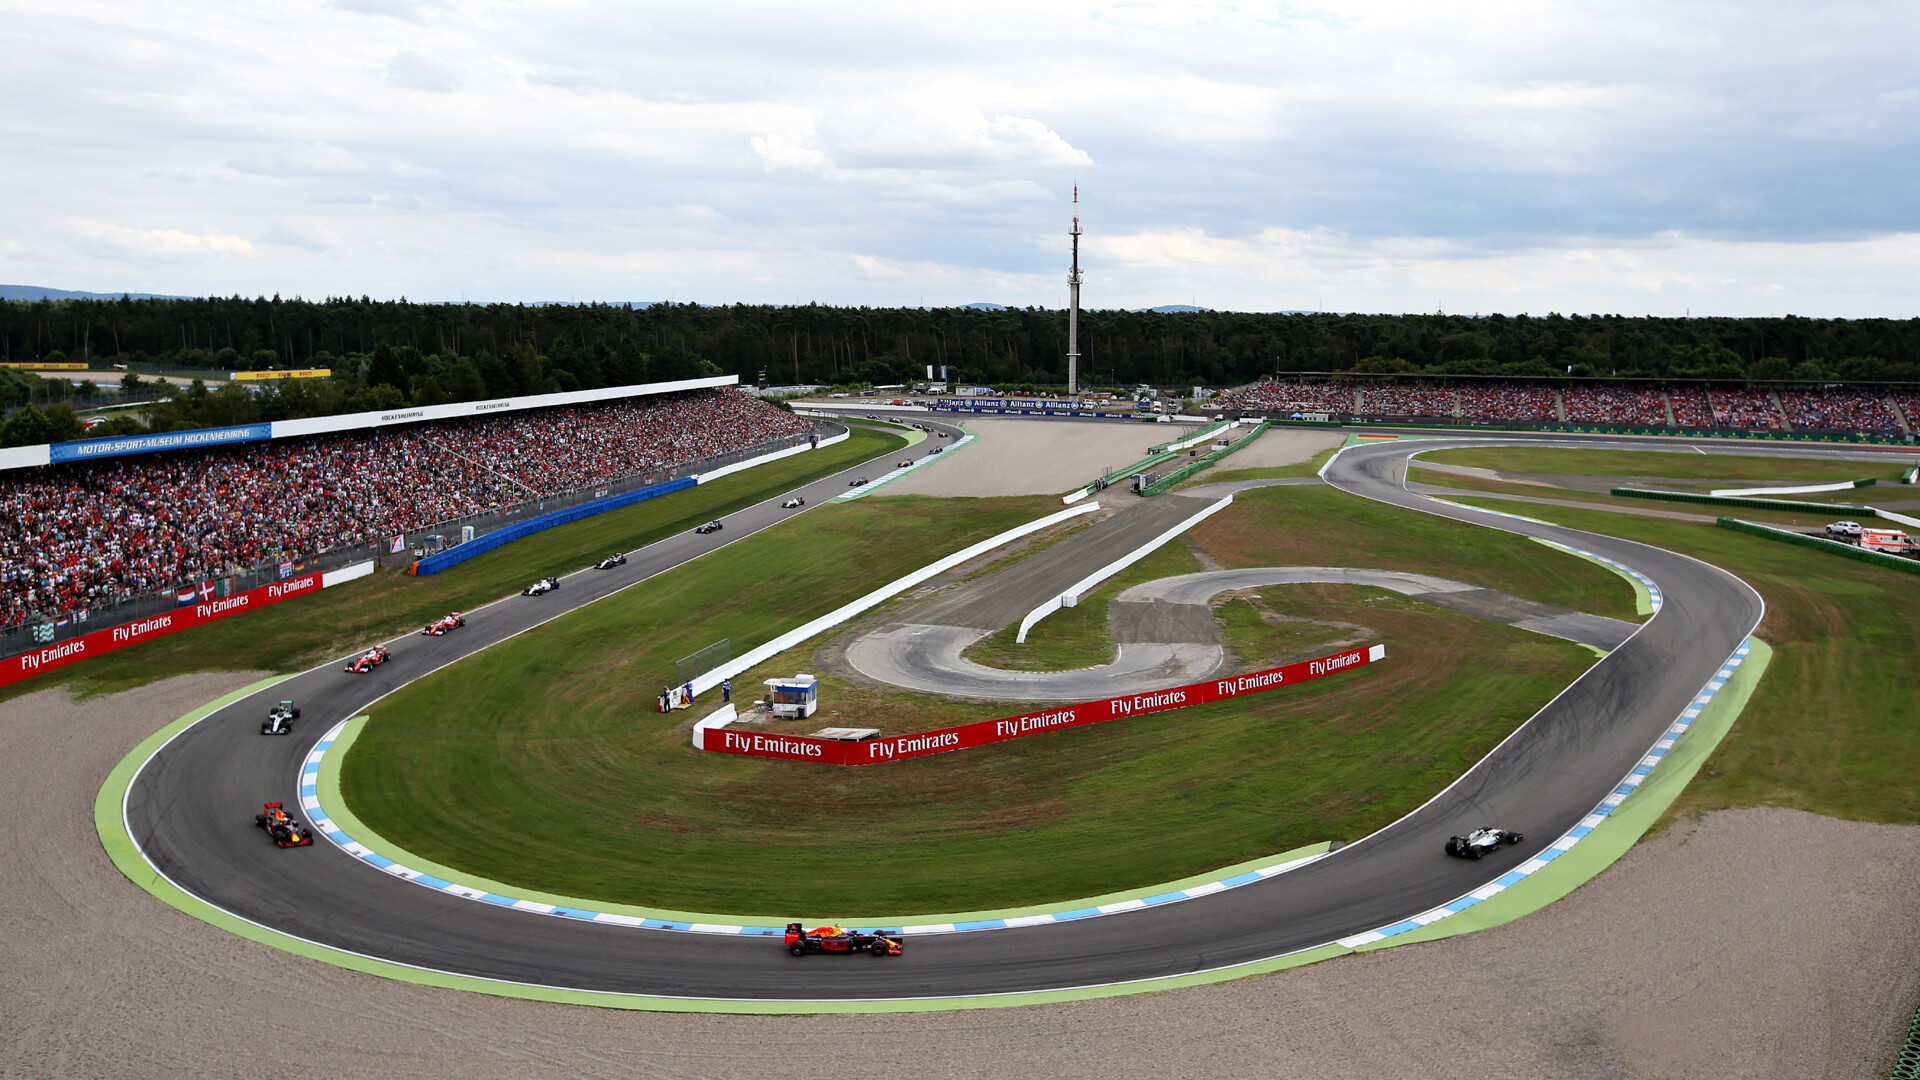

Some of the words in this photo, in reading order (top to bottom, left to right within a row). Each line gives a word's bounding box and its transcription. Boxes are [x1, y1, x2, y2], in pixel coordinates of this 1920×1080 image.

[78, 436, 182, 455] MOTOR-SPORT-MUSEUM
[184, 430, 250, 444] HOCKENHEIMRING
[268, 586, 282, 597] Fly
[283, 577, 314, 593] Emirates
[197, 605, 212, 617] Fly
[213, 595, 248, 613] Emirates
[113, 628, 129, 641] Fly
[131, 616, 172, 636] Emirates
[21, 655, 39, 670] Fly
[41, 641, 85, 663] Emirates
[1310, 662, 1325, 675] Fly
[1327, 652, 1360, 670] Emirates
[1218, 681, 1236, 695] Fly
[1238, 671, 1283, 691] Emirates
[1111, 700, 1131, 714] Fly
[1134, 691, 1186, 710] Emirates
[997, 721, 1018, 736] Fly
[1021, 710, 1075, 731] Emirates
[725, 733, 751, 752] Fly
[754, 735, 822, 756] Emirates
[870, 742, 894, 759] Fly
[898, 732, 959, 754] Emirates
